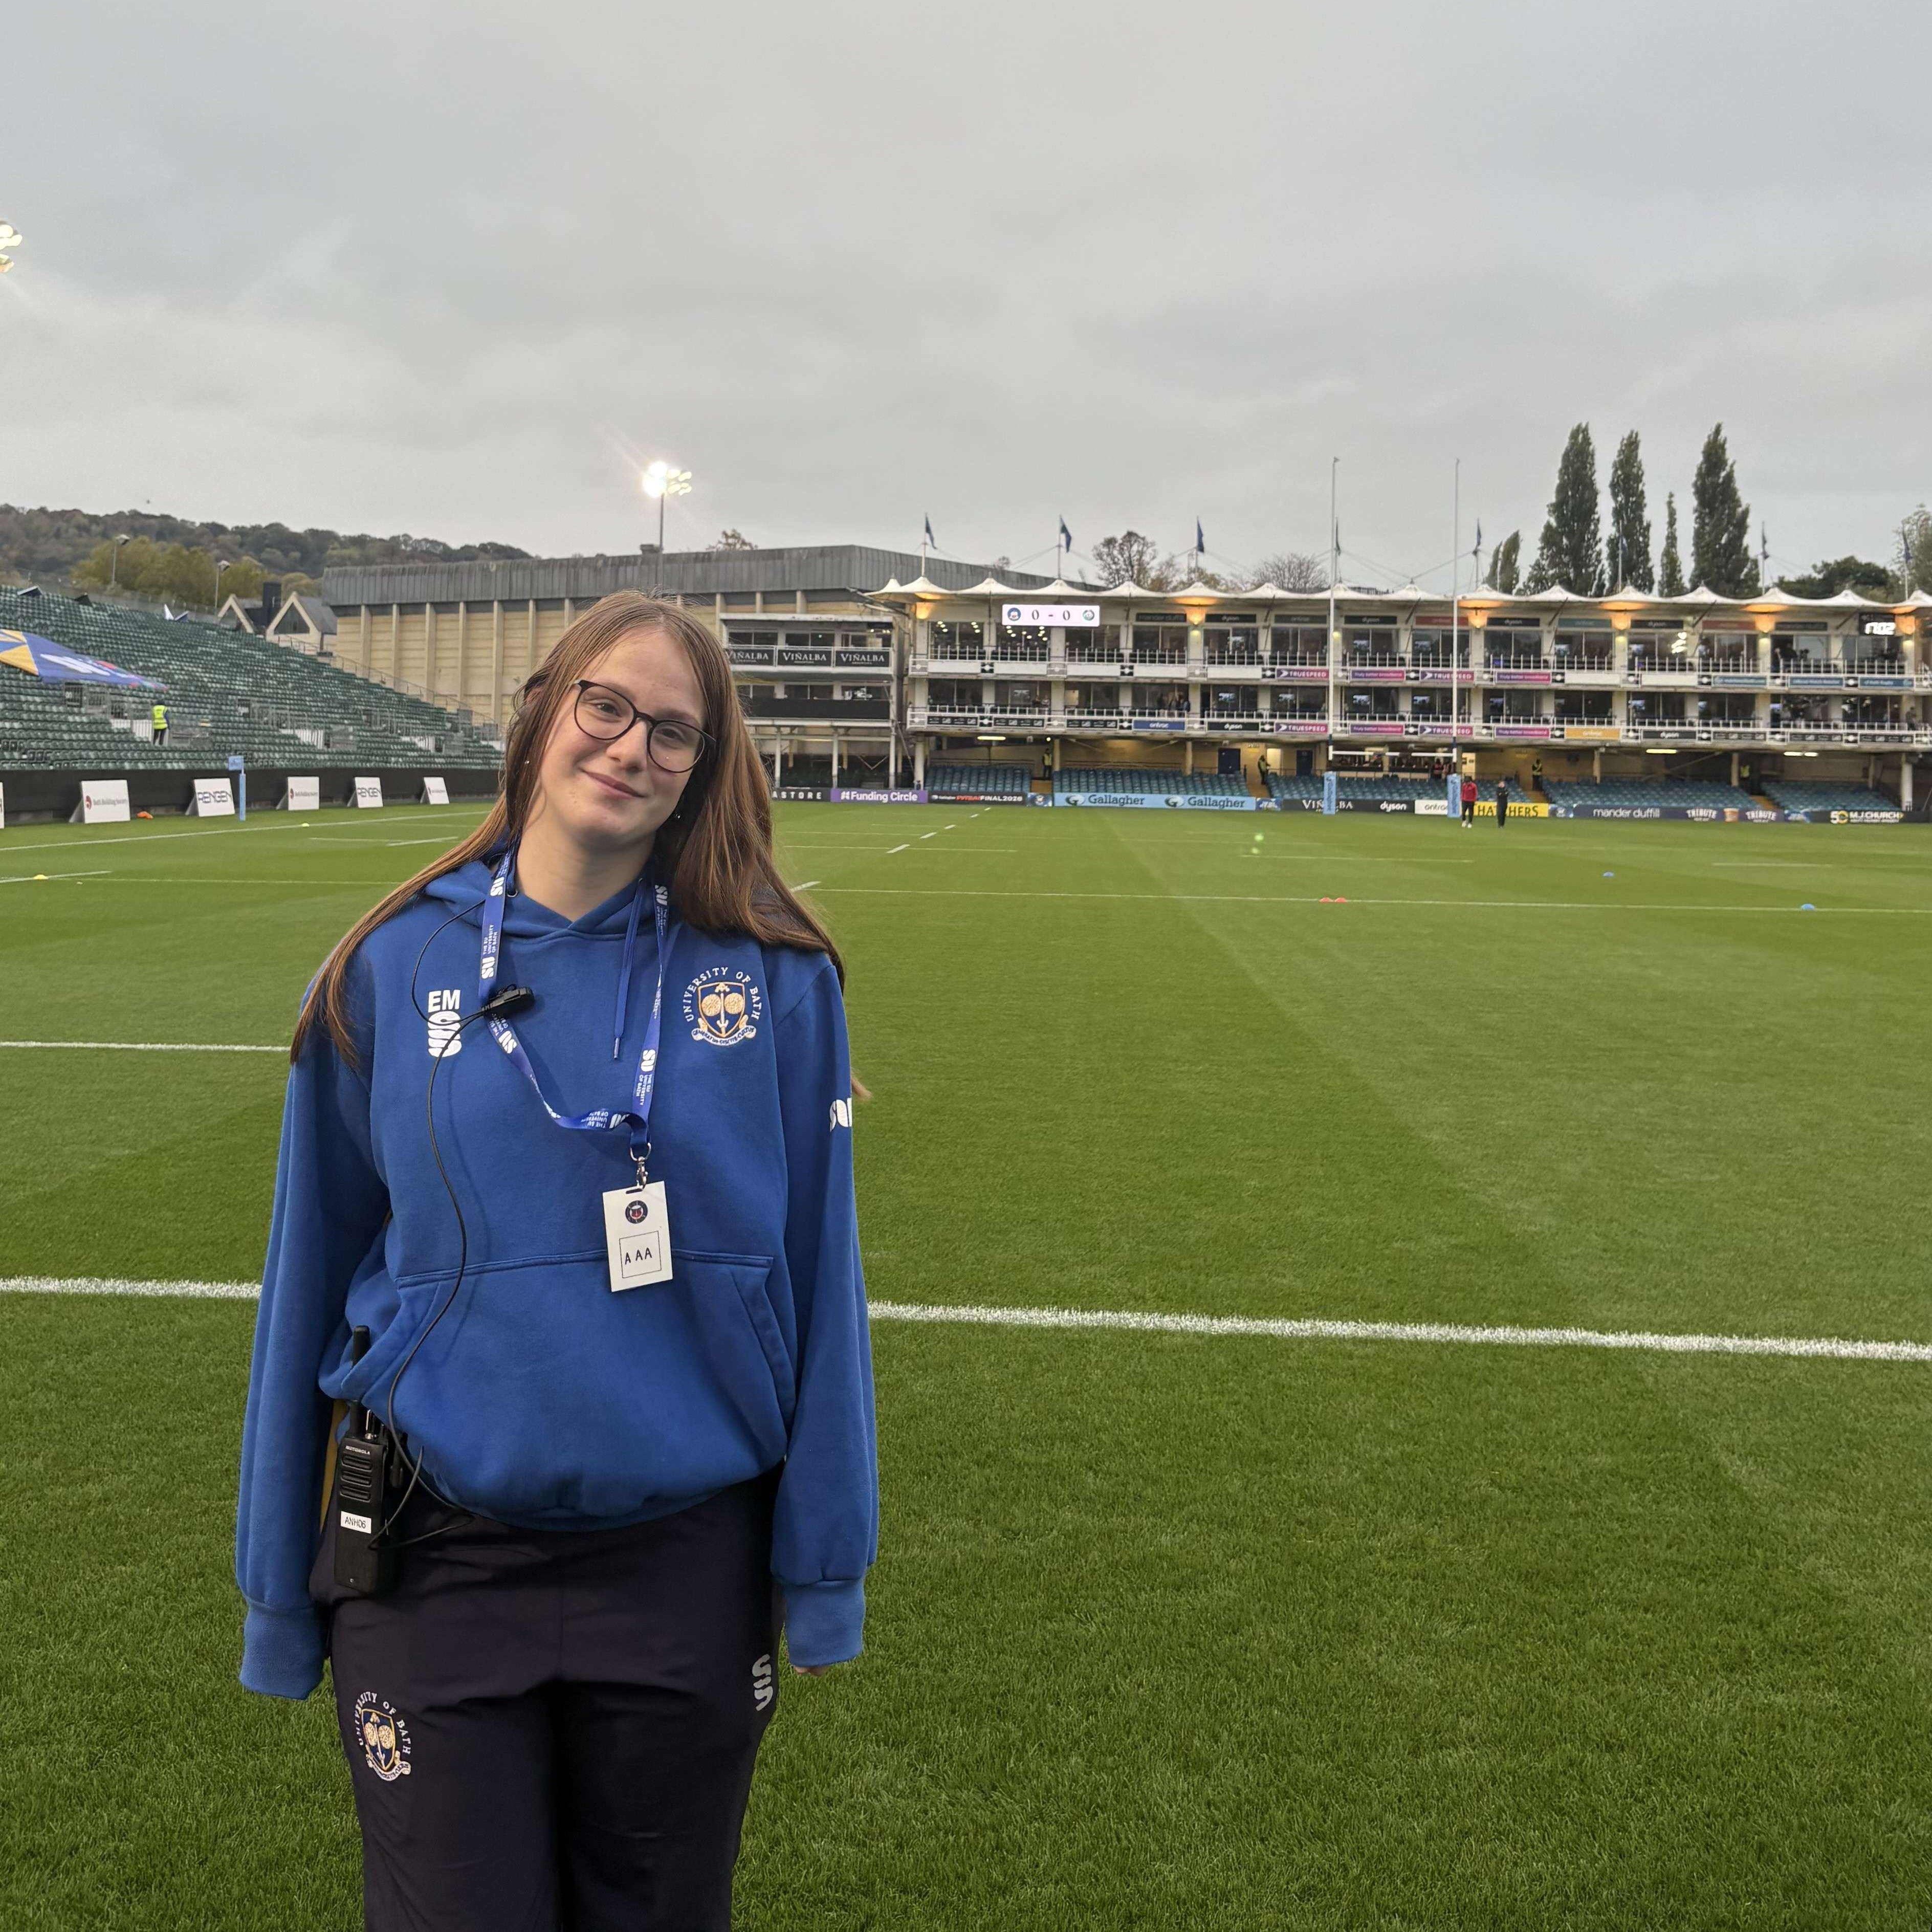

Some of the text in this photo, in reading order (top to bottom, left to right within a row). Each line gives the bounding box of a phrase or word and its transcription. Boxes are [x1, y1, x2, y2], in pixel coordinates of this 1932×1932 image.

[1031, 609, 1039, 620] 0
[1063, 610, 1070, 621] 0
[783, 652, 827, 661] VIÑALBA
[841, 653, 885, 662] VIÑALBA
[851, 792, 917, 803] Funding Circle
[1088, 794, 1145, 807] Gallagher
[1188, 797, 1245, 808] Gallagher
[1380, 801, 1407, 813] dyson
[1593, 808, 1660, 818] mander duffill
[1686, 808, 1717, 819] TRIBUTE
[1745, 810, 1777, 821] TRIBUTE
[683, 967, 729, 1022] UNIVERSITY
[736, 972, 751, 983] OF
[749, 986, 762, 1020] BATH
[346, 1445, 370, 1455] MOTOROLA
[396, 1719, 411, 1754] BATH
